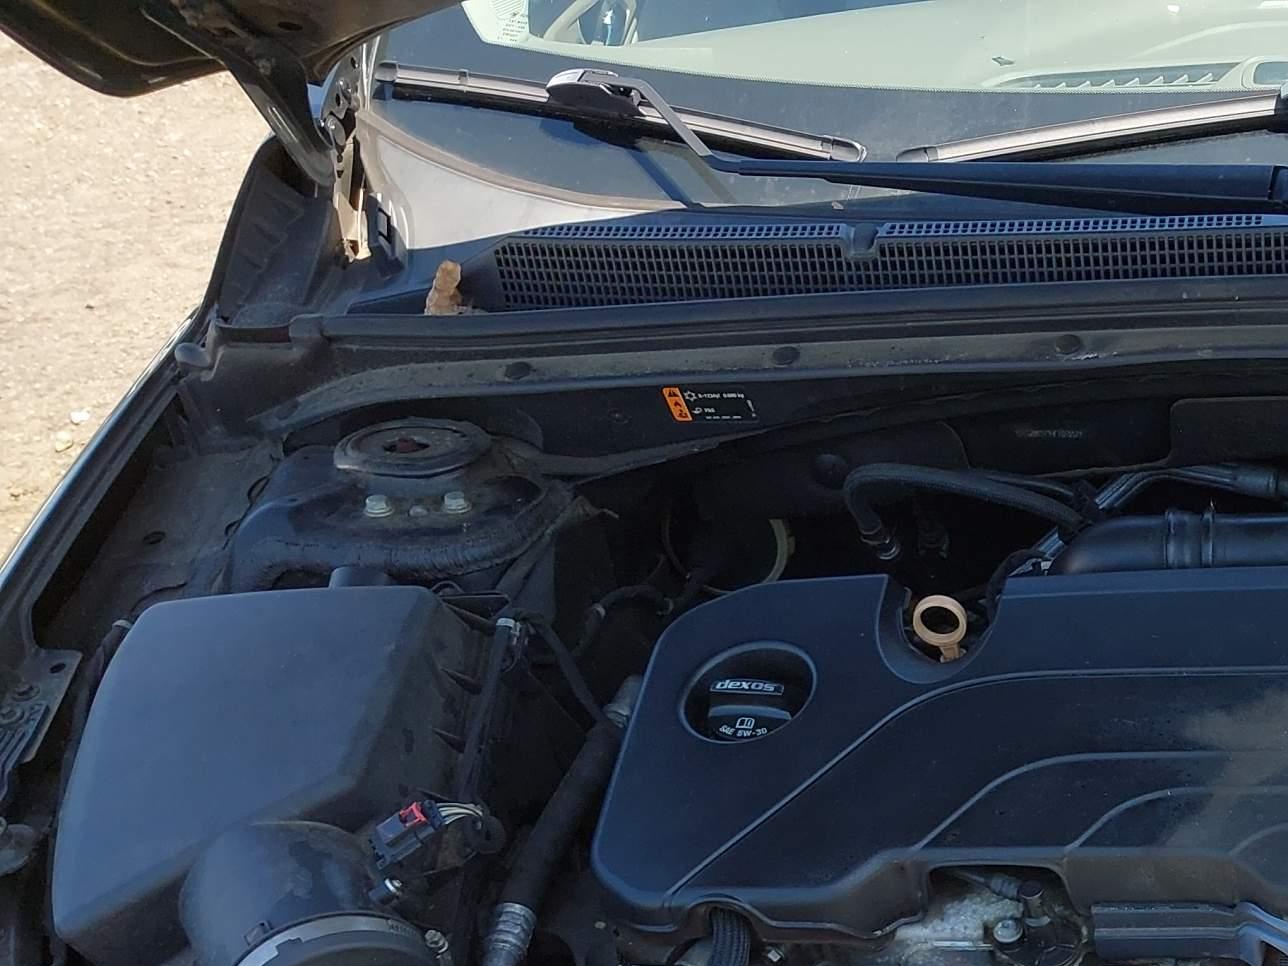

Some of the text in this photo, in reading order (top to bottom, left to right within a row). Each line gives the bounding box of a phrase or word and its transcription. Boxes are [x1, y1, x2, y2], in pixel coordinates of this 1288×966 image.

[715, 679, 776, 692] dexos
[719, 724, 768, 737] SAE 5W-30
